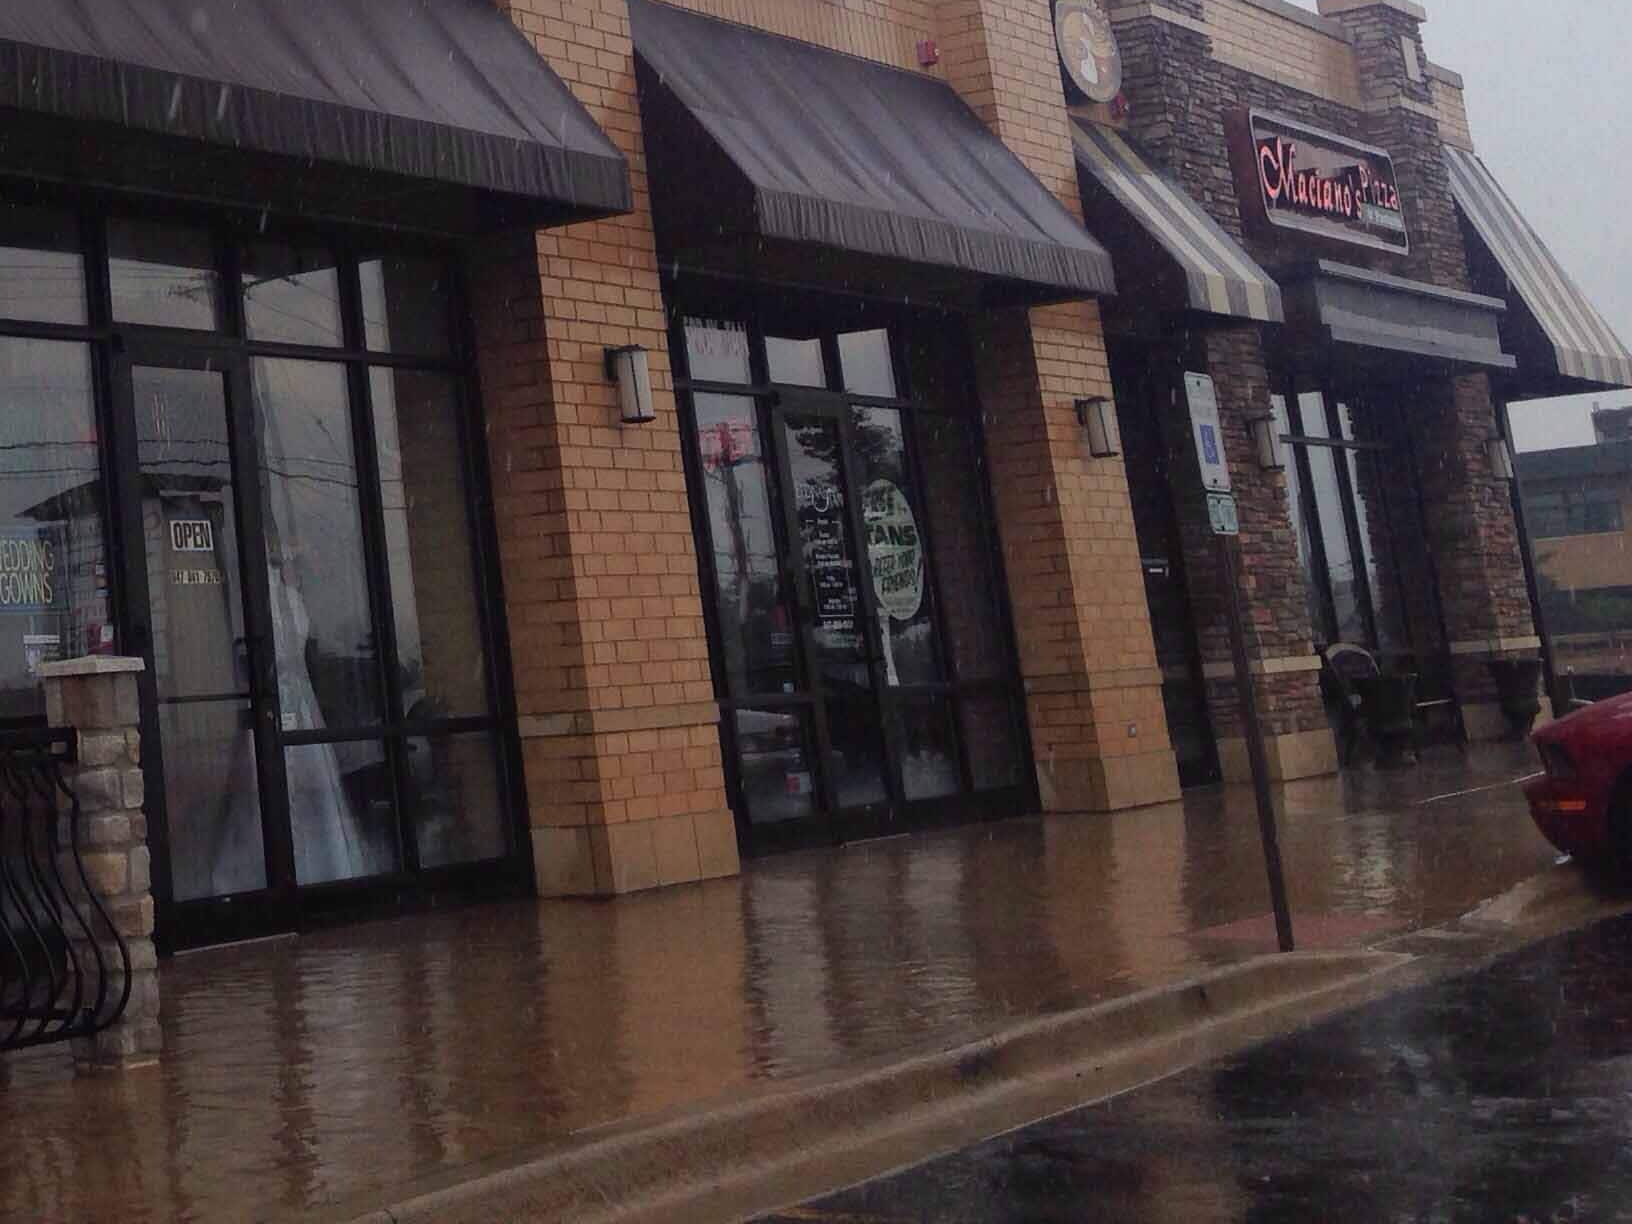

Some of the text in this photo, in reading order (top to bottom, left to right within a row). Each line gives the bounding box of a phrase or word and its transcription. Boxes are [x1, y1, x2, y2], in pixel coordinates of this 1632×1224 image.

[1359, 161, 1400, 210] Pizza
[173, 522, 211, 549] OPEN
[0, 572, 53, 605] GOWNS
